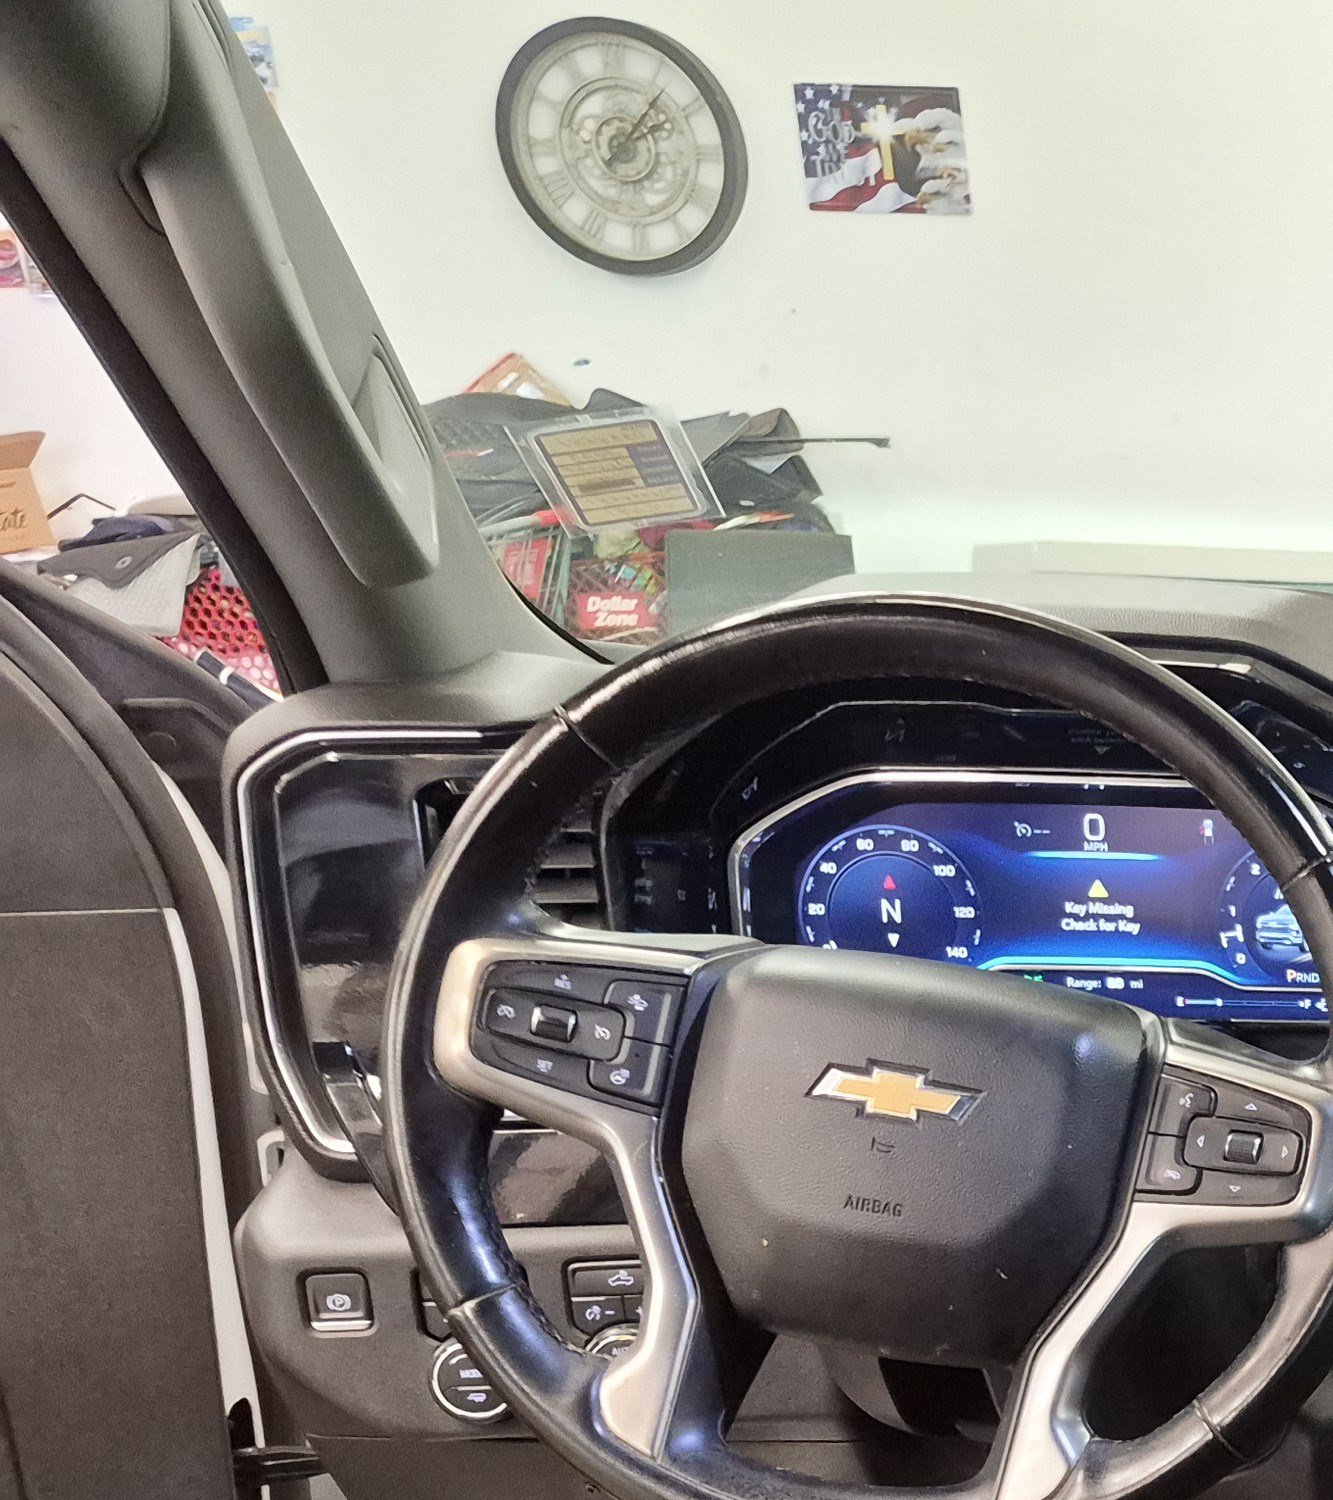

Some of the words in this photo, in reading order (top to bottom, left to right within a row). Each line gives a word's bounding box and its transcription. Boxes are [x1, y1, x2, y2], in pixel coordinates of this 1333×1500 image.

[586, 595, 639, 613] Dollar
[594, 612, 639, 627] Zone
[1083, 813, 1106, 841] 0
[856, 838, 874, 851] 60
[901, 839, 919, 852] 80
[1083, 841, 1109, 852] MPH
[819, 862, 837, 875] 40
[933, 864, 956, 877] 100
[807, 903, 826, 916] 20
[880, 898, 902, 924] N
[953, 906, 975, 919] 120
[1064, 901, 1087, 917] Key
[1088, 902, 1135, 918] Missing
[1061, 918, 1098, 932] Check
[1099, 919, 1117, 932] for
[1118, 920, 1141, 935] Key
[946, 946, 968, 959] 140
[1066, 976, 1101, 991] Range:
[1130, 978, 1144, 989] mi
[842, 1195, 903, 1218] AIRBAG
